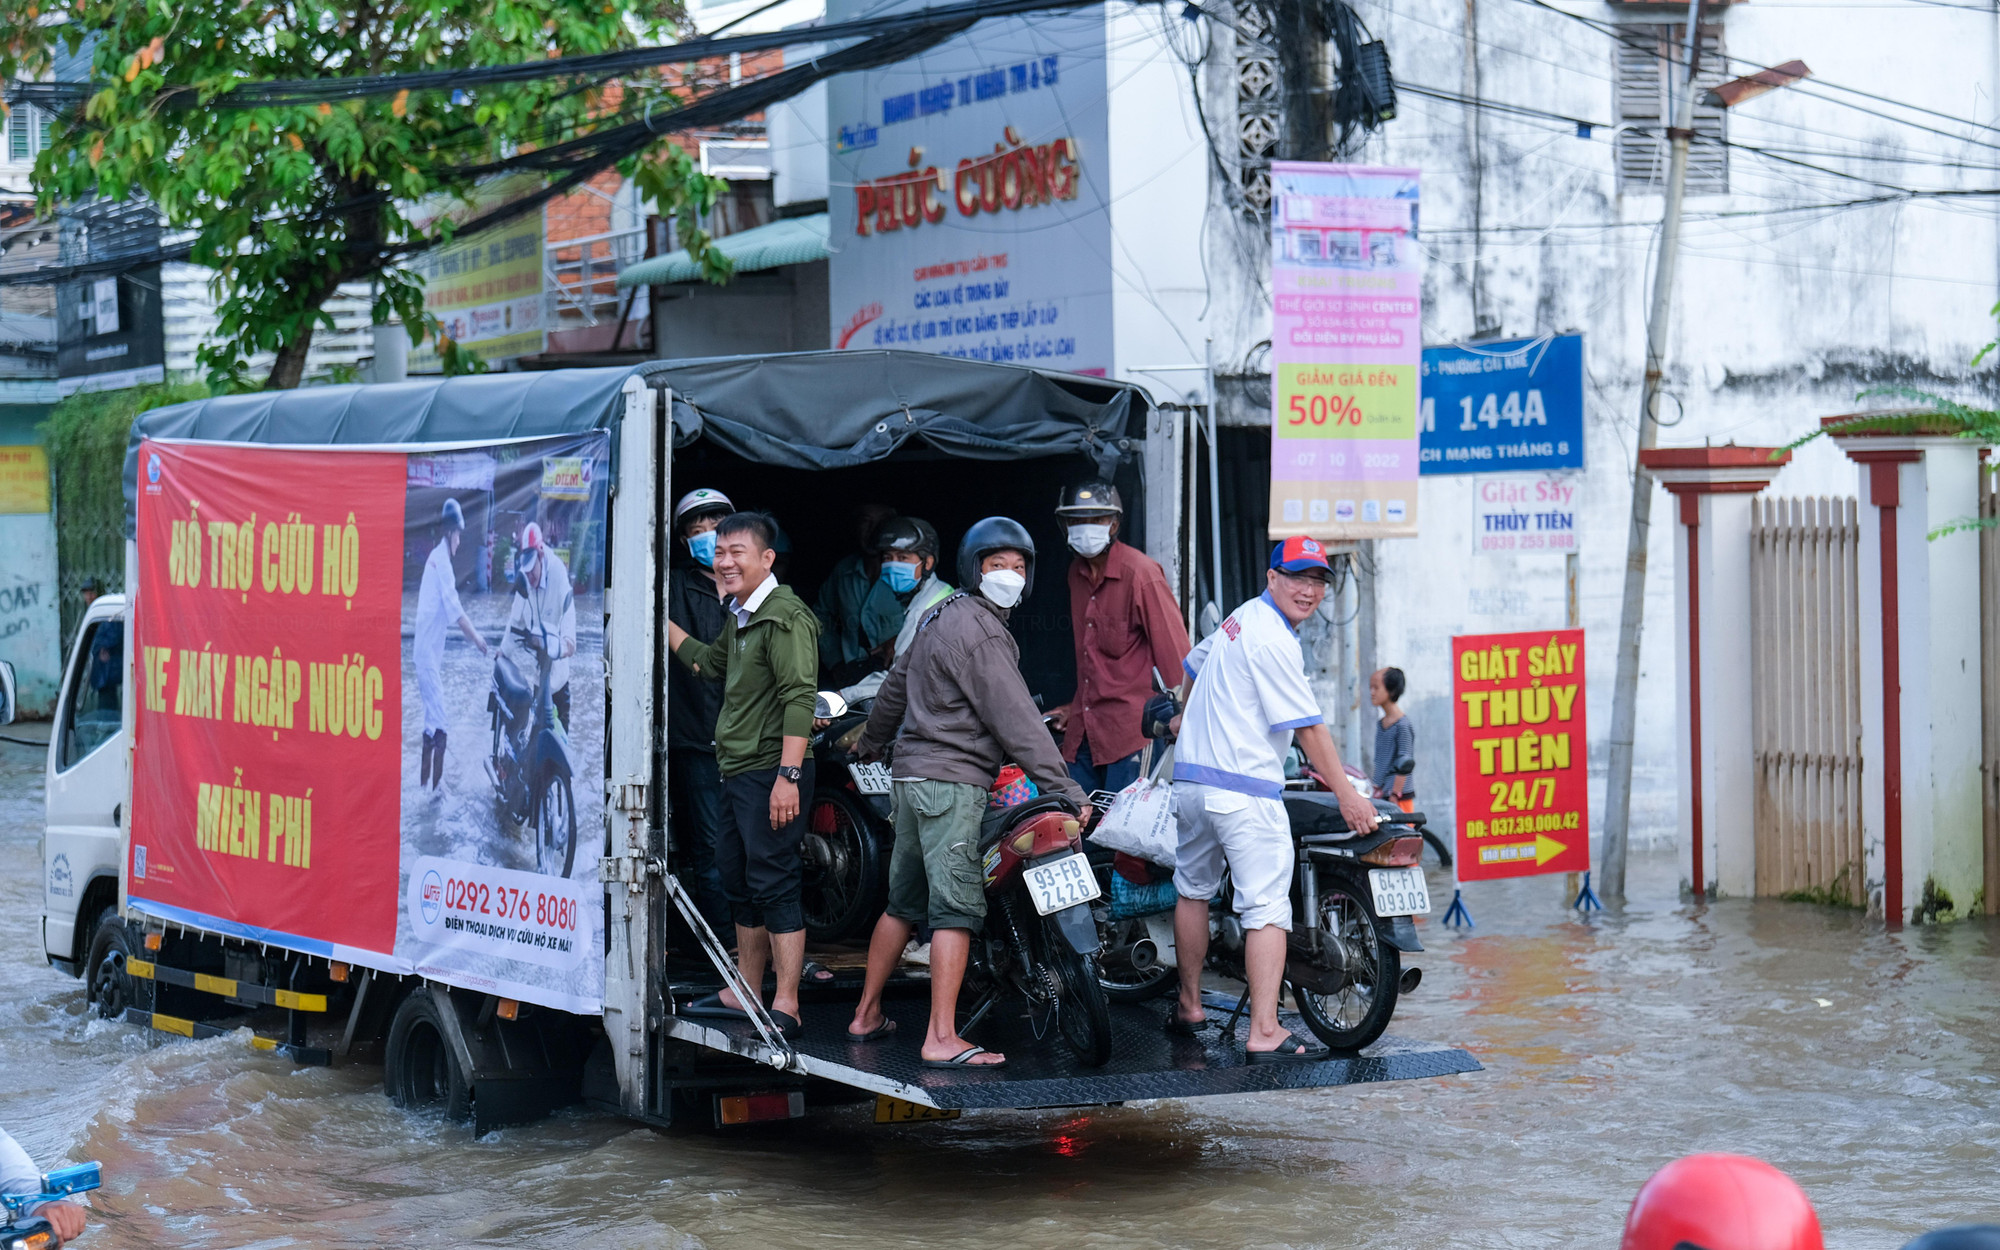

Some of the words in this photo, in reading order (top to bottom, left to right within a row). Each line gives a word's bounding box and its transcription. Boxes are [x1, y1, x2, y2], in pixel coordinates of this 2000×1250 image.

[855, 146, 946, 236] PHÚC
[1371, 301, 1415, 314] CENTER
[1296, 368, 1334, 387] GIẢM
[1338, 371, 1365, 387] GIÁ
[1368, 371, 1399, 388] ĐẾN
[1288, 394, 1363, 427] 50%
[1459, 389, 1548, 432] 144A
[1297, 452, 1317, 467] 07
[1329, 453, 1347, 467] 10
[1363, 453, 1401, 469] 2022
[1446, 445, 1493, 463] MẠNG
[1496, 440, 1553, 459] THÁNG
[1557, 441, 1570, 457] 8
[1535, 510, 1574, 531] TIÊN
[169, 498, 202, 589] HỖ
[207, 511, 257, 605] TRỢ
[261, 511, 315, 595] CỨU
[321, 511, 360, 611] HỘ
[1481, 535, 1515, 551] 0939
[1519, 535, 1545, 550] 255
[1460, 643, 1522, 685] GIẶT
[1527, 635, 1578, 679] SẤY
[144, 645, 172, 714] XE
[174, 640, 229, 721] MÁY
[233, 645, 302, 742] NGẬP
[308, 651, 384, 741] NƯỚC
[1460, 678, 1579, 729] THỦY
[1472, 729, 1571, 775] TIÊN
[1489, 777, 1556, 813] 24/7
[196, 765, 261, 861] MIỄN
[267, 787, 314, 870] PHÍ
[1490, 811, 1580, 837] 037.39.000.42
[1034, 859, 1082, 890] 93-FB
[1378, 871, 1416, 891] 64-F1
[445, 878, 490, 915] 0292
[496, 886, 530, 922] 376
[536, 893, 577, 932] 8080
[1042, 879, 1090, 910] 2426
[1377, 891, 1426, 913] 093.03
[445, 915, 464, 934] ĐIỆN
[465, 920, 488, 939] THOẠI
[488, 925, 505, 941] DỊCH
[507, 928, 518, 945] VỤ
[517, 928, 533, 945] CỨU
[534, 931, 546, 951] HỘ
[546, 935, 557, 950] XE
[558, 936, 573, 954] MÁY
